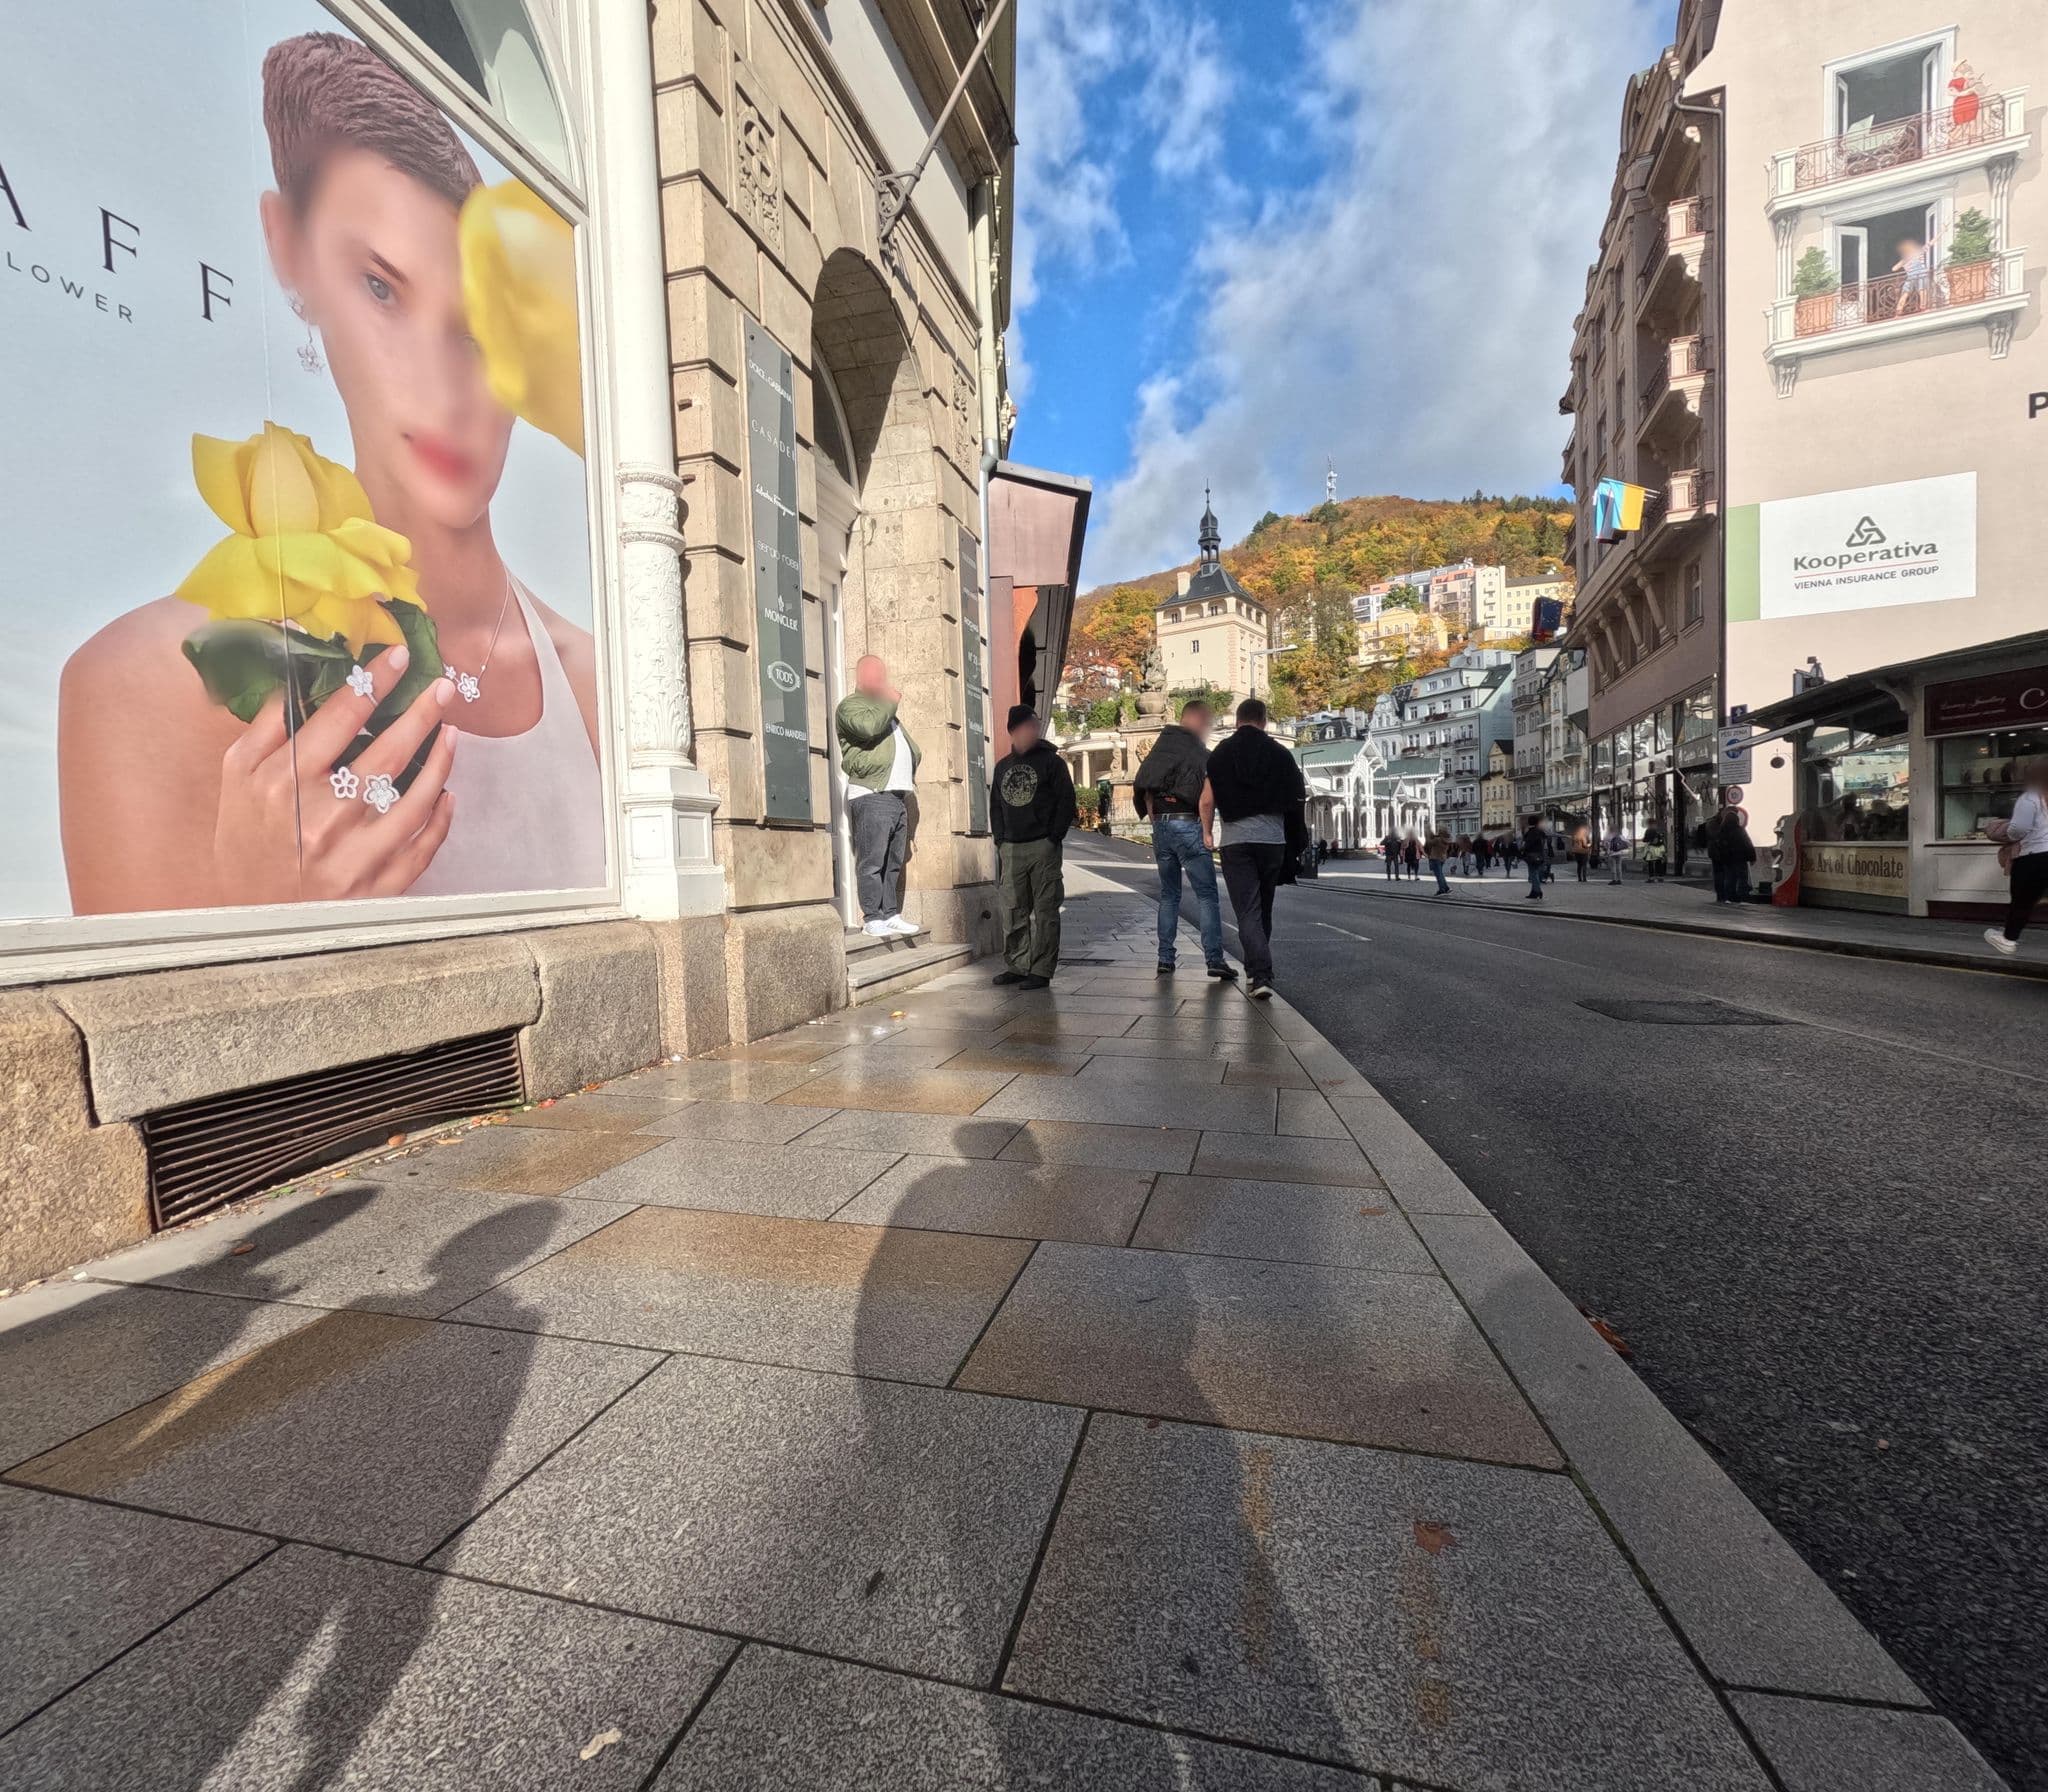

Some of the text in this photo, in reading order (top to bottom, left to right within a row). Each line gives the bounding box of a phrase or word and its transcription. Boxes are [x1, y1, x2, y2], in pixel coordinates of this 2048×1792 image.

[1793, 541, 1939, 572] Kooperativa
[1794, 565, 1940, 590] VIENNA INSURANCE GROUP
[764, 607, 798, 632] MONCLER
[1818, 853, 1834, 874] Art
[1835, 854, 1844, 874] of
[1847, 854, 1904, 879] Chocolate
